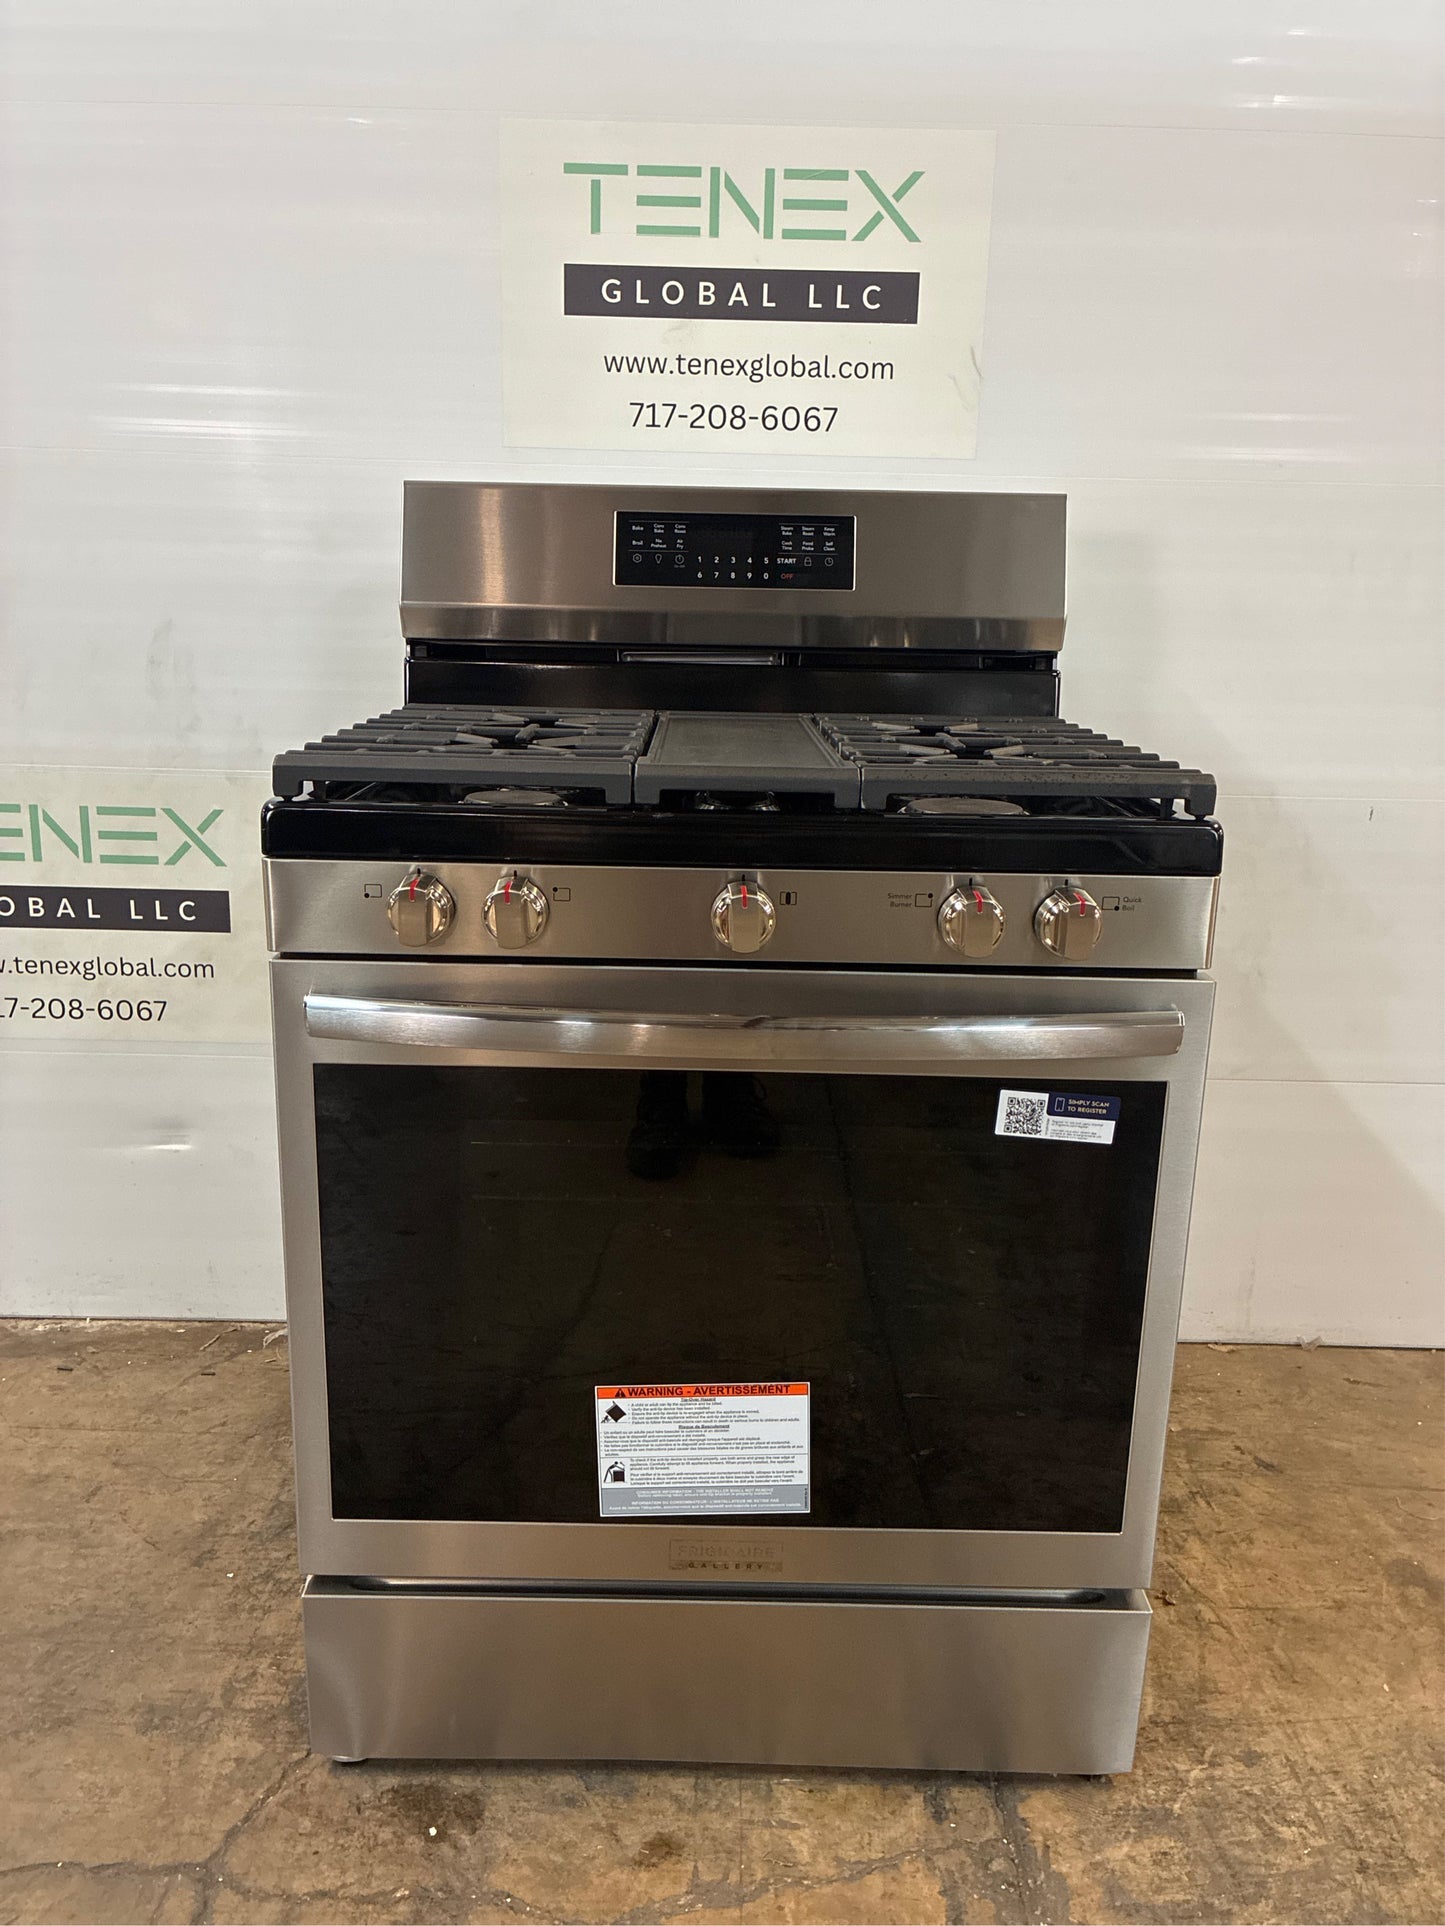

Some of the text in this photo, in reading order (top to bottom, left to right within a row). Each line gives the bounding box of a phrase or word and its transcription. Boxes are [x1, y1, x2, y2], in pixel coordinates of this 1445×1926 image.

[564, 162, 926, 243] TENEX
[601, 278, 882, 310] GLOBAL LLC
[604, 353, 894, 383] www.tenexglobal.com
[629, 402, 838, 433] 717-208-6067
[130, 900, 196, 921] LLC
[0, 956, 214, 980] .tenexglobal.com
[628, 1387, 683, 1396] WARNING
[693, 1385, 790, 1395] AVERTISSEMENT
[678, 1545, 775, 1557] FRIGIDAIRE
